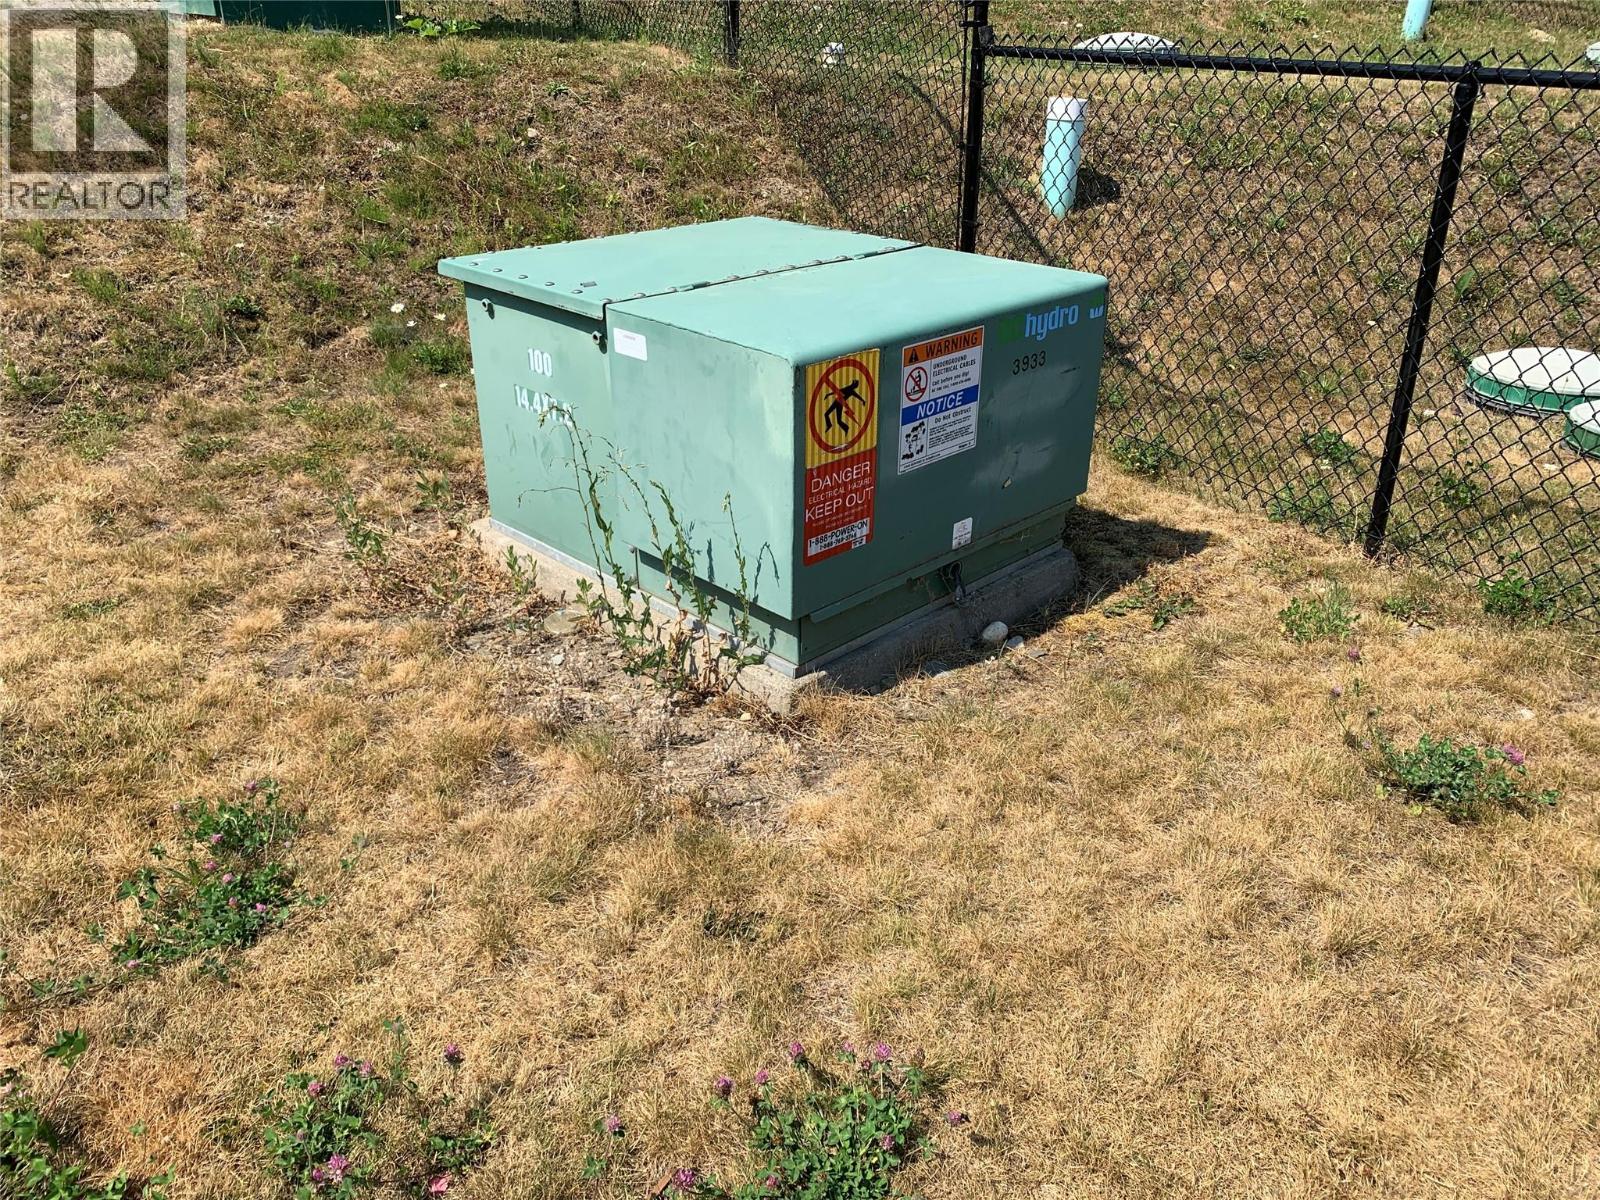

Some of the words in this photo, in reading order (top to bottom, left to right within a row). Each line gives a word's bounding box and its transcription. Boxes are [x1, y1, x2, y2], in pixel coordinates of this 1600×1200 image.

[1024, 303, 1080, 342] hydro
[925, 331, 979, 360] WARNING
[527, 347, 553, 378] 100
[932, 354, 968, 370] UNDERGROUND
[932, 364, 959, 377] ELECTRICAL
[959, 358, 977, 370] CABLES
[1012, 350, 1047, 376] 3933
[916, 391, 964, 419] NOTICE
[942, 413, 951, 421] Not
[952, 406, 972, 418] Obstruct
[808, 487, 845, 505] ELECTRICAL
[848, 477, 873, 491] HAZARD
[811, 461, 871, 493] DANGER
[805, 498, 842, 523] KEEP
[845, 486, 875, 508] OUT
